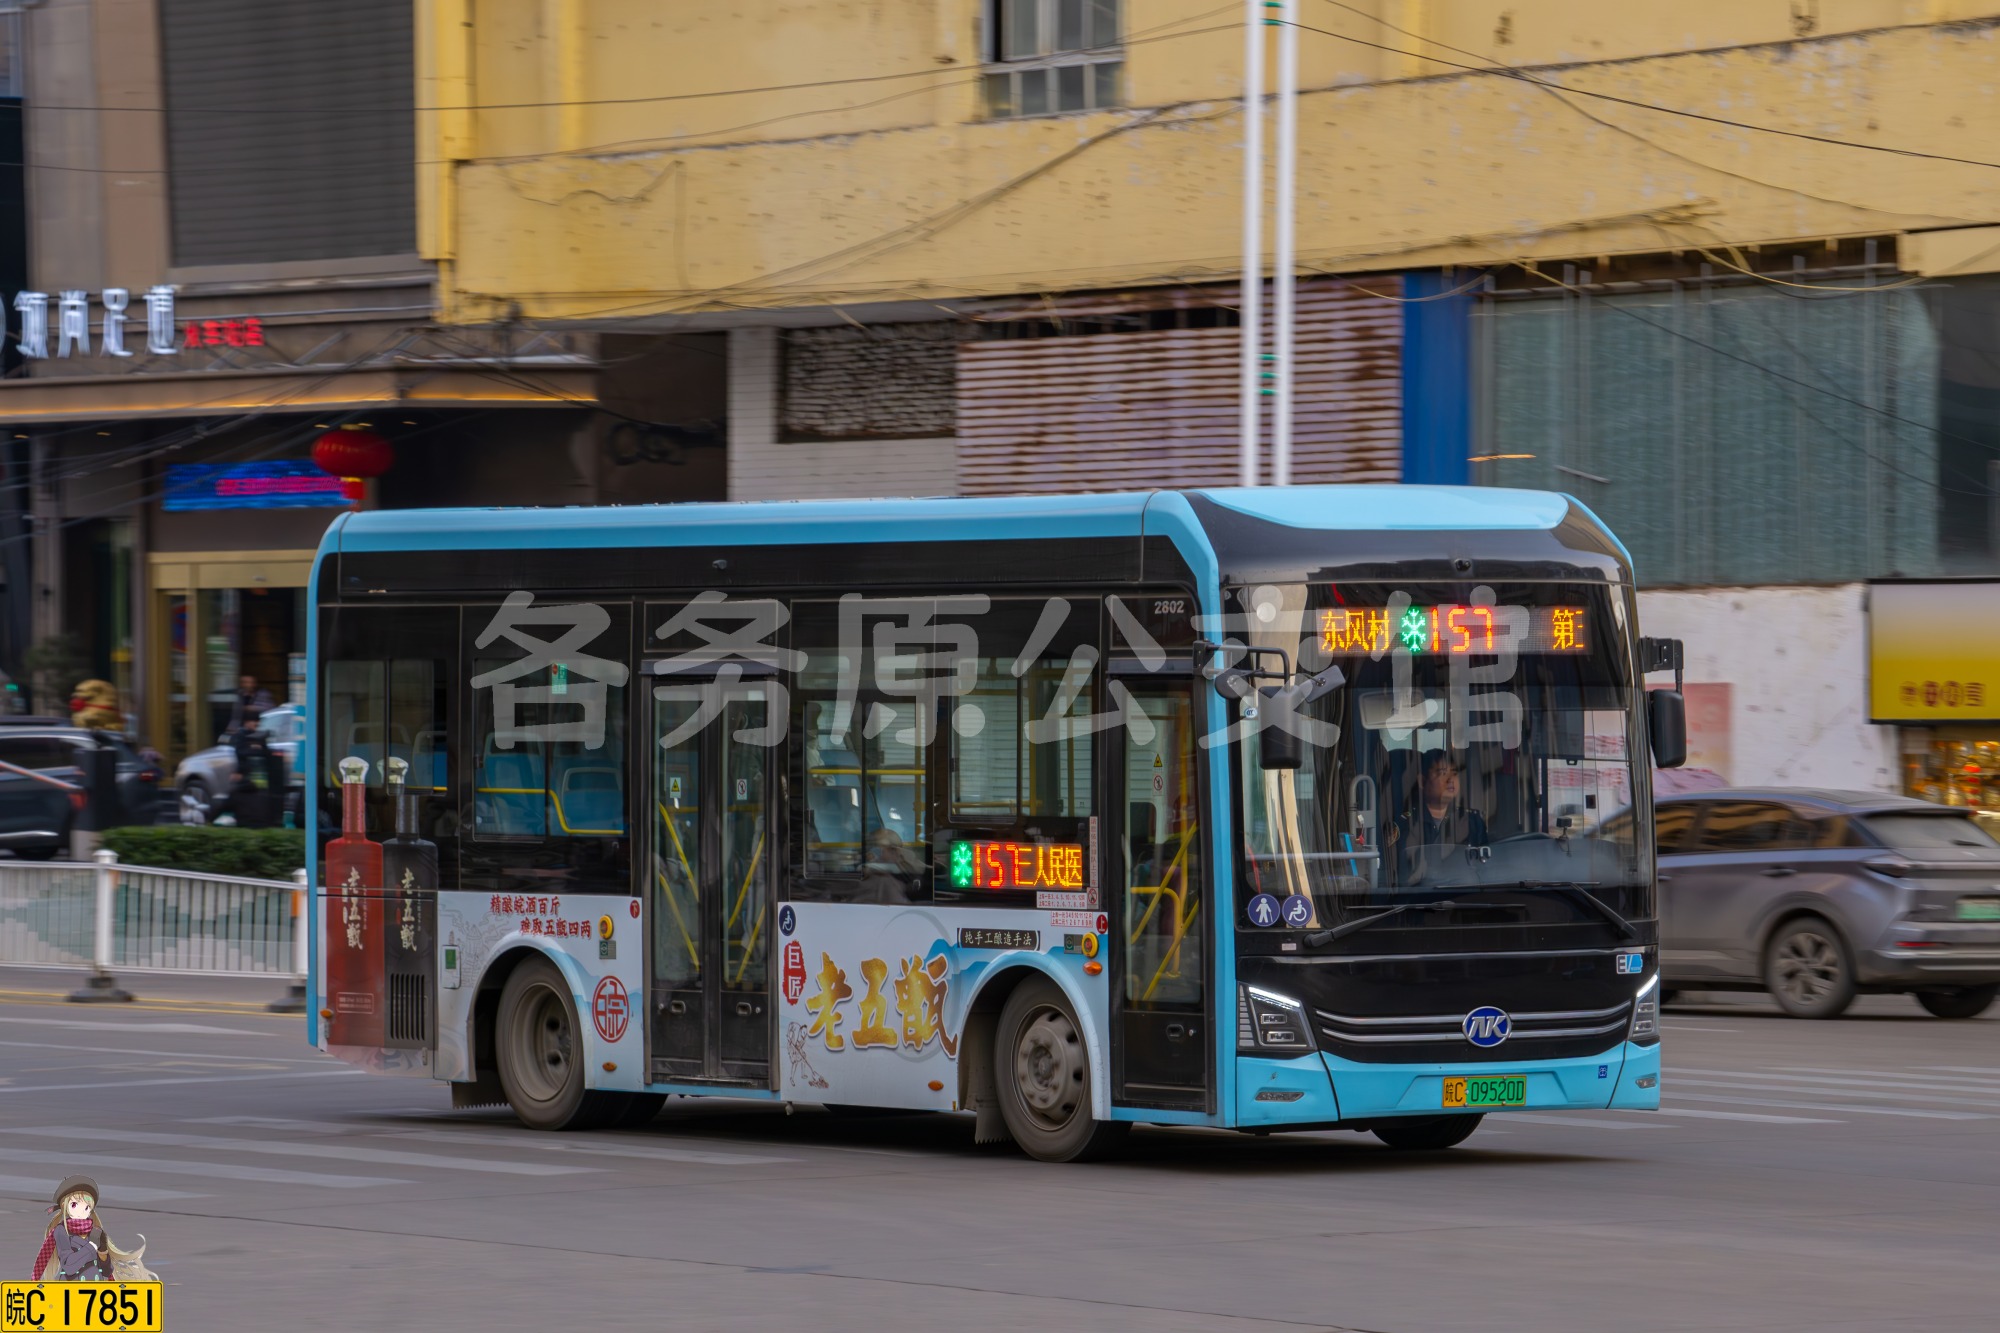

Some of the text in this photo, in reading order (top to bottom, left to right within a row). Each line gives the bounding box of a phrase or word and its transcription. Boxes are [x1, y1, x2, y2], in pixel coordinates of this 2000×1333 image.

[1154, 600, 1184, 614] 2802
[1321, 609, 1390, 652] 东风村
[1431, 607, 1494, 652] 157
[490, 894, 560, 915] 精酿皖酒百斤
[964, 930, 1032, 946] 纯手工酿造手法
[788, 945, 802, 1000] 巨匠
[805, 952, 958, 1058] 老五甑
[1470, 1080, 1525, 1103] 09520D
